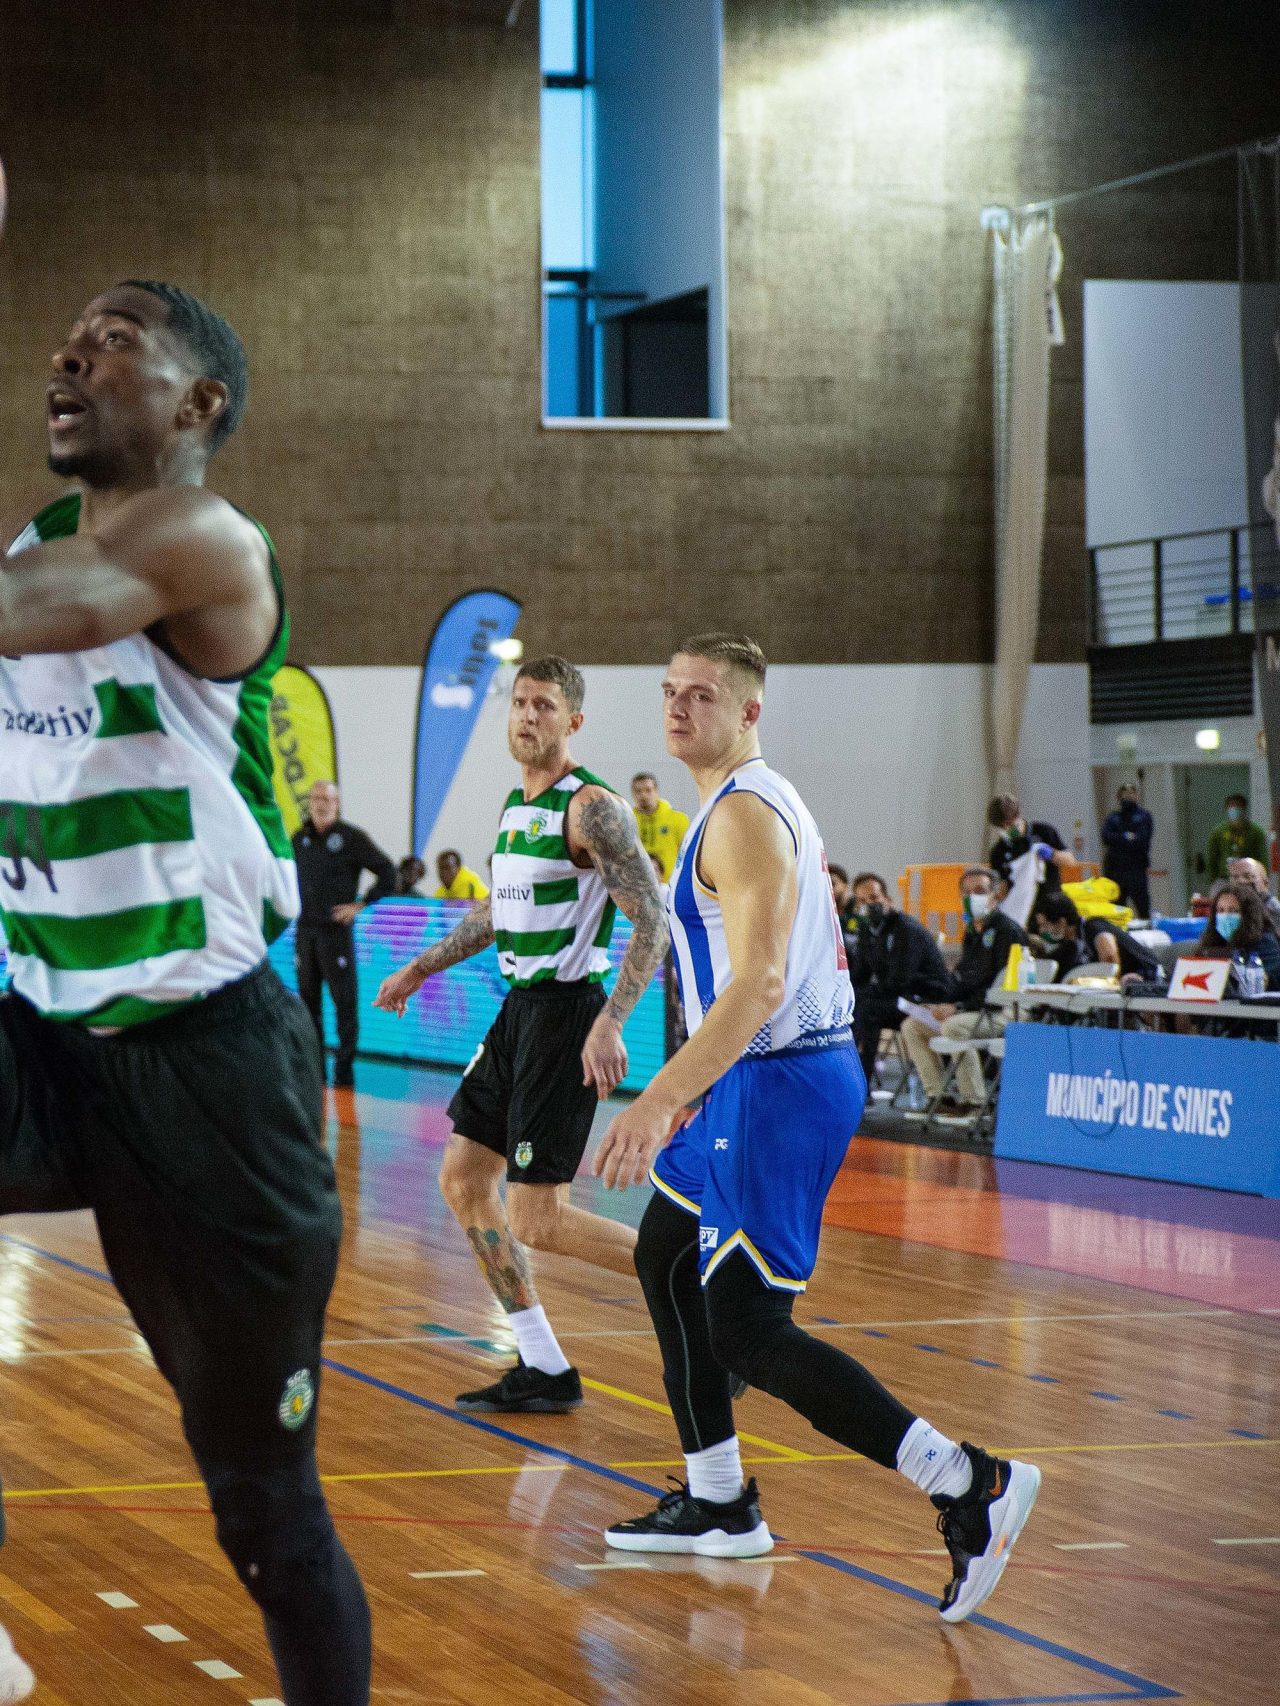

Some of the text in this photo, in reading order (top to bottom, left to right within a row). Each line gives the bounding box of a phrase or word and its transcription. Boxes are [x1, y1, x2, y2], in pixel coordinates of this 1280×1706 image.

[1046, 1069, 1233, 1139] MUNICÍPIO DE SINES
